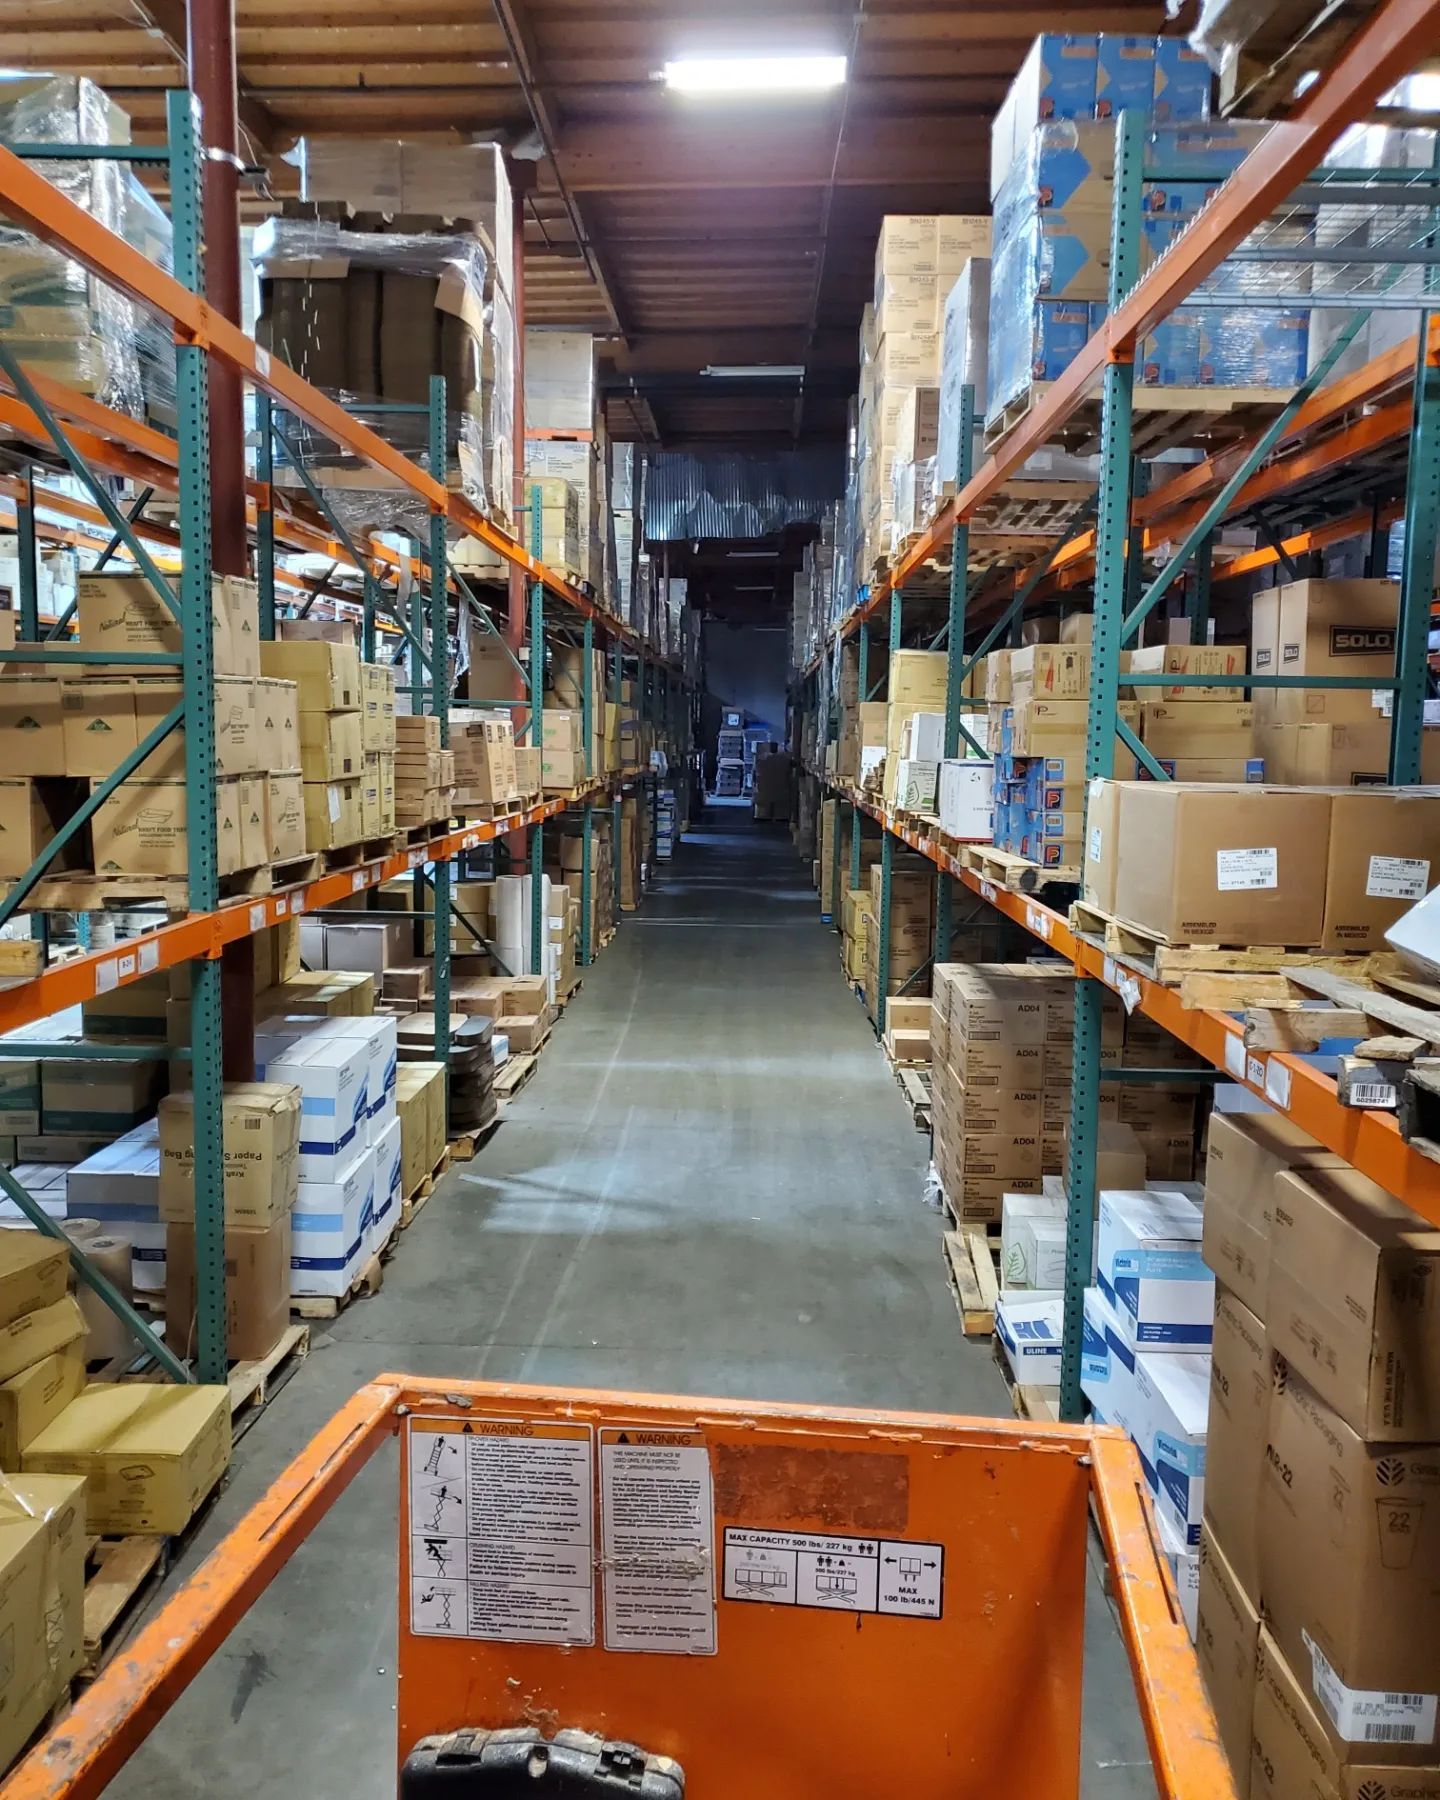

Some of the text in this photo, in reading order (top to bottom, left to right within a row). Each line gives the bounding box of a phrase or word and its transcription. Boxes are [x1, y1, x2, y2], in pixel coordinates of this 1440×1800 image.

[1335, 634, 1391, 649] SOLO
[1017, 1004, 1040, 1012] AD04
[1016, 1049, 1038, 1057] AD04
[1013, 1137, 1035, 1145] AD04
[164, 1149, 182, 1160] Bag
[233, 1153, 262, 1161] Paper
[1026, 1347, 1048, 1355] ULINE
[480, 1424, 534, 1436] WARNING
[636, 1433, 692, 1445] WARNING
[729, 1533, 747, 1542] MAX
[750, 1535, 790, 1546] CAPACITY
[792, 1539, 807, 1547] 500
[825, 1542, 840, 1550] 227
[842, 1544, 853, 1553] kg
[898, 1586, 917, 1595] MAX
